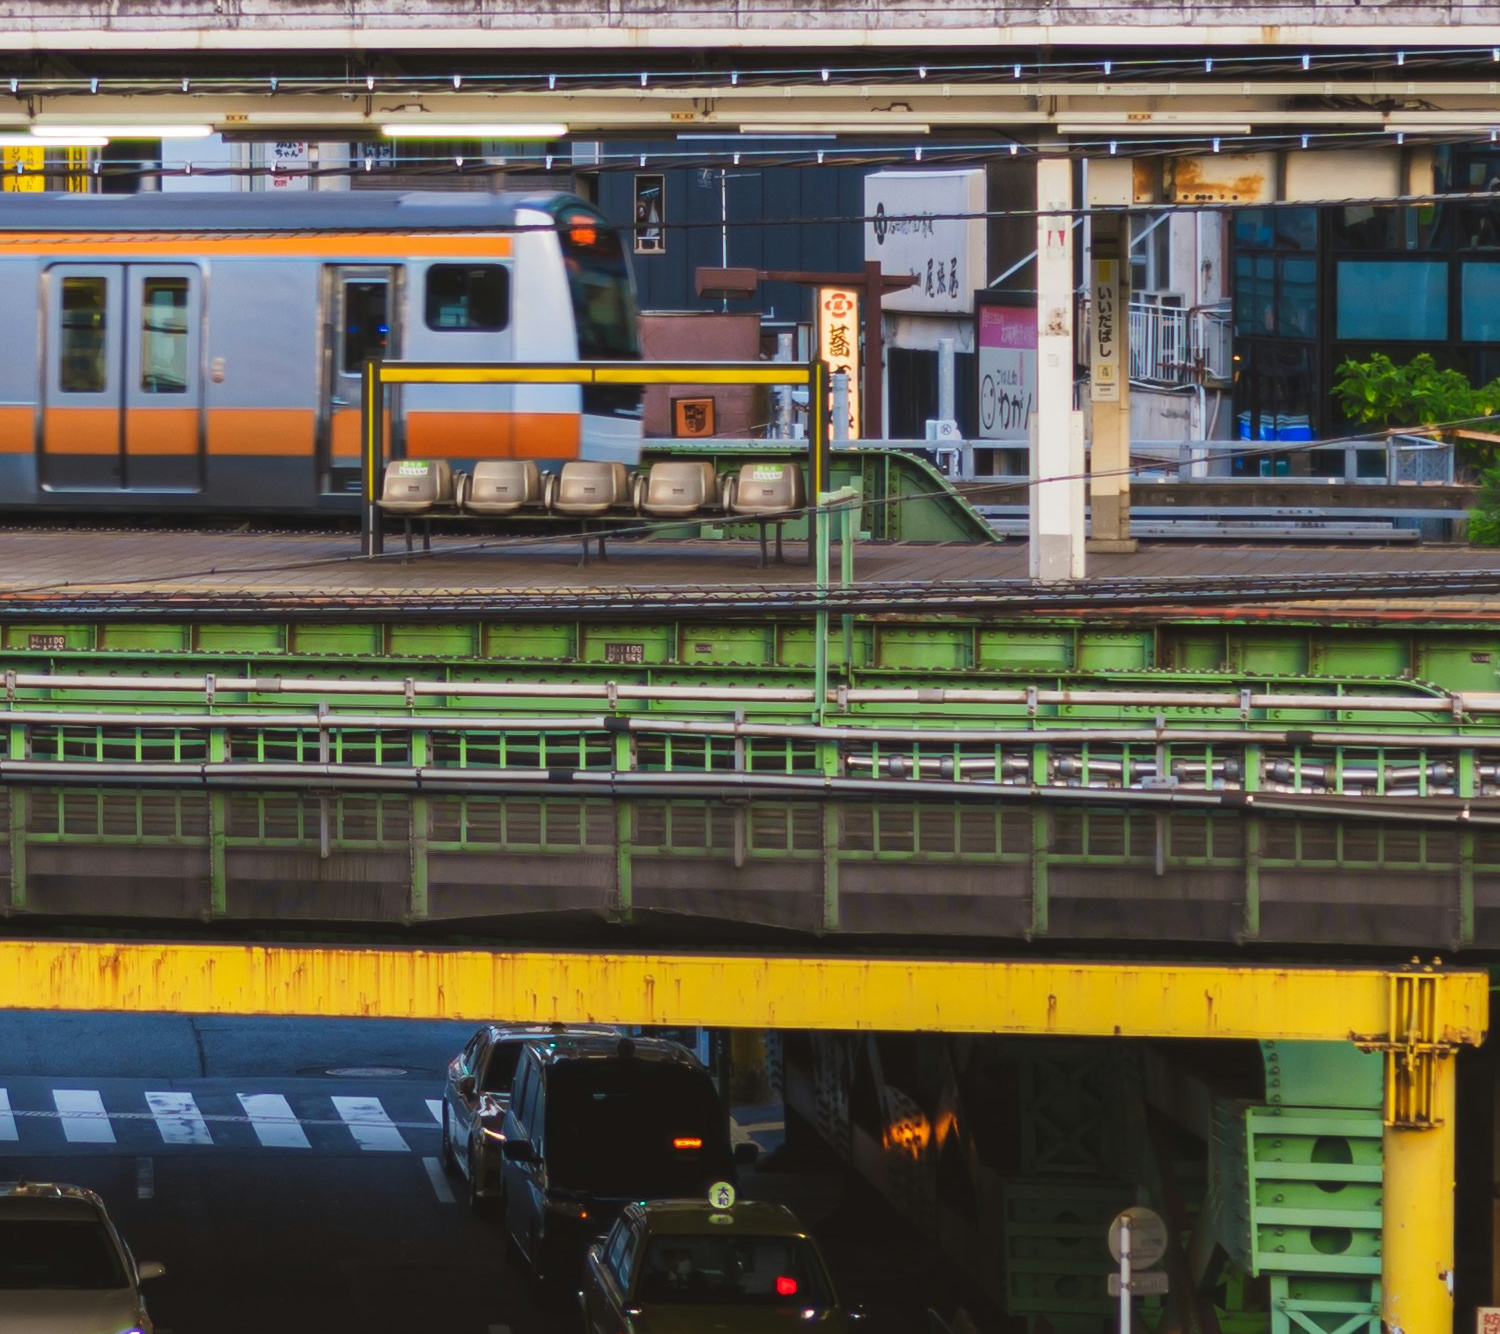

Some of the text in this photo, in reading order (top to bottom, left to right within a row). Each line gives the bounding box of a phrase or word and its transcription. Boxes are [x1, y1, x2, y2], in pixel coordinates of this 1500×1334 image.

[1097, 286, 1113, 358] いいだばし
